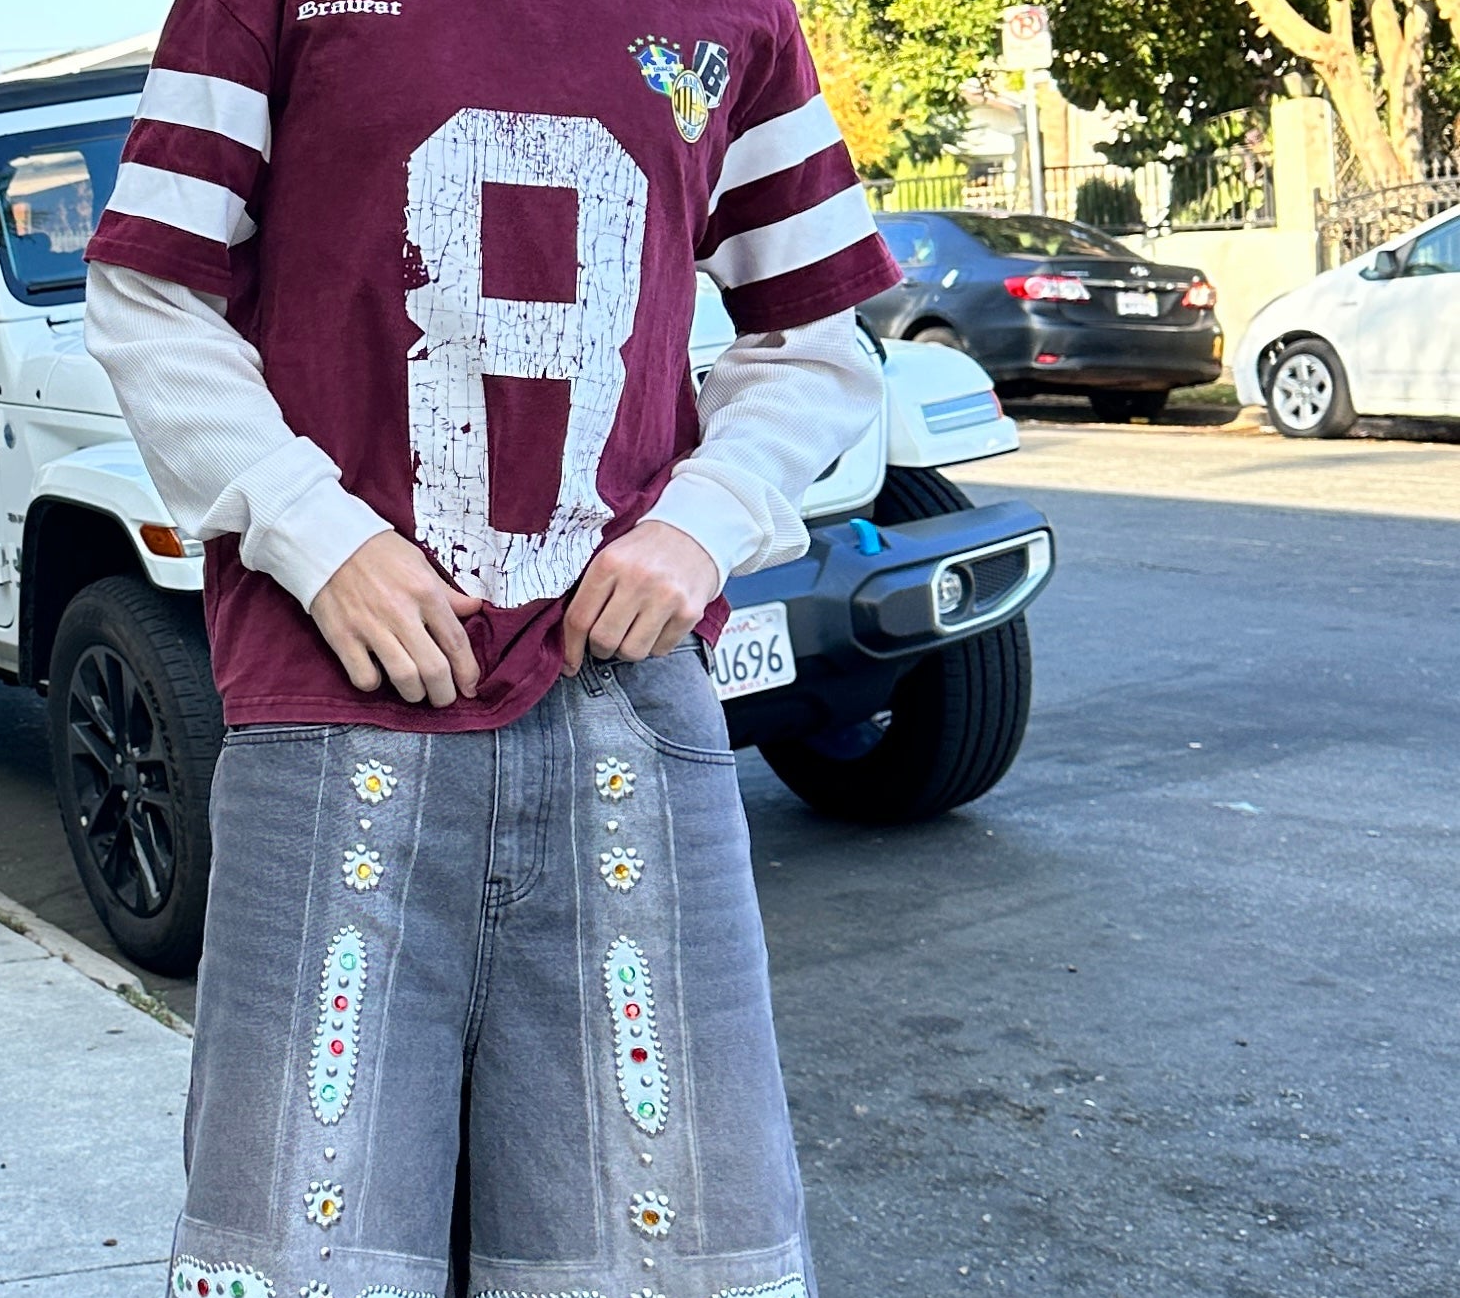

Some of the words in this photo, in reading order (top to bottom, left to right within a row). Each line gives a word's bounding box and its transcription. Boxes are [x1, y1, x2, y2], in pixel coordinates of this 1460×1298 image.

[296, 0, 402, 20] Bravest
[404, 107, 649, 609] 8
[714, 634, 783, 685] U696
